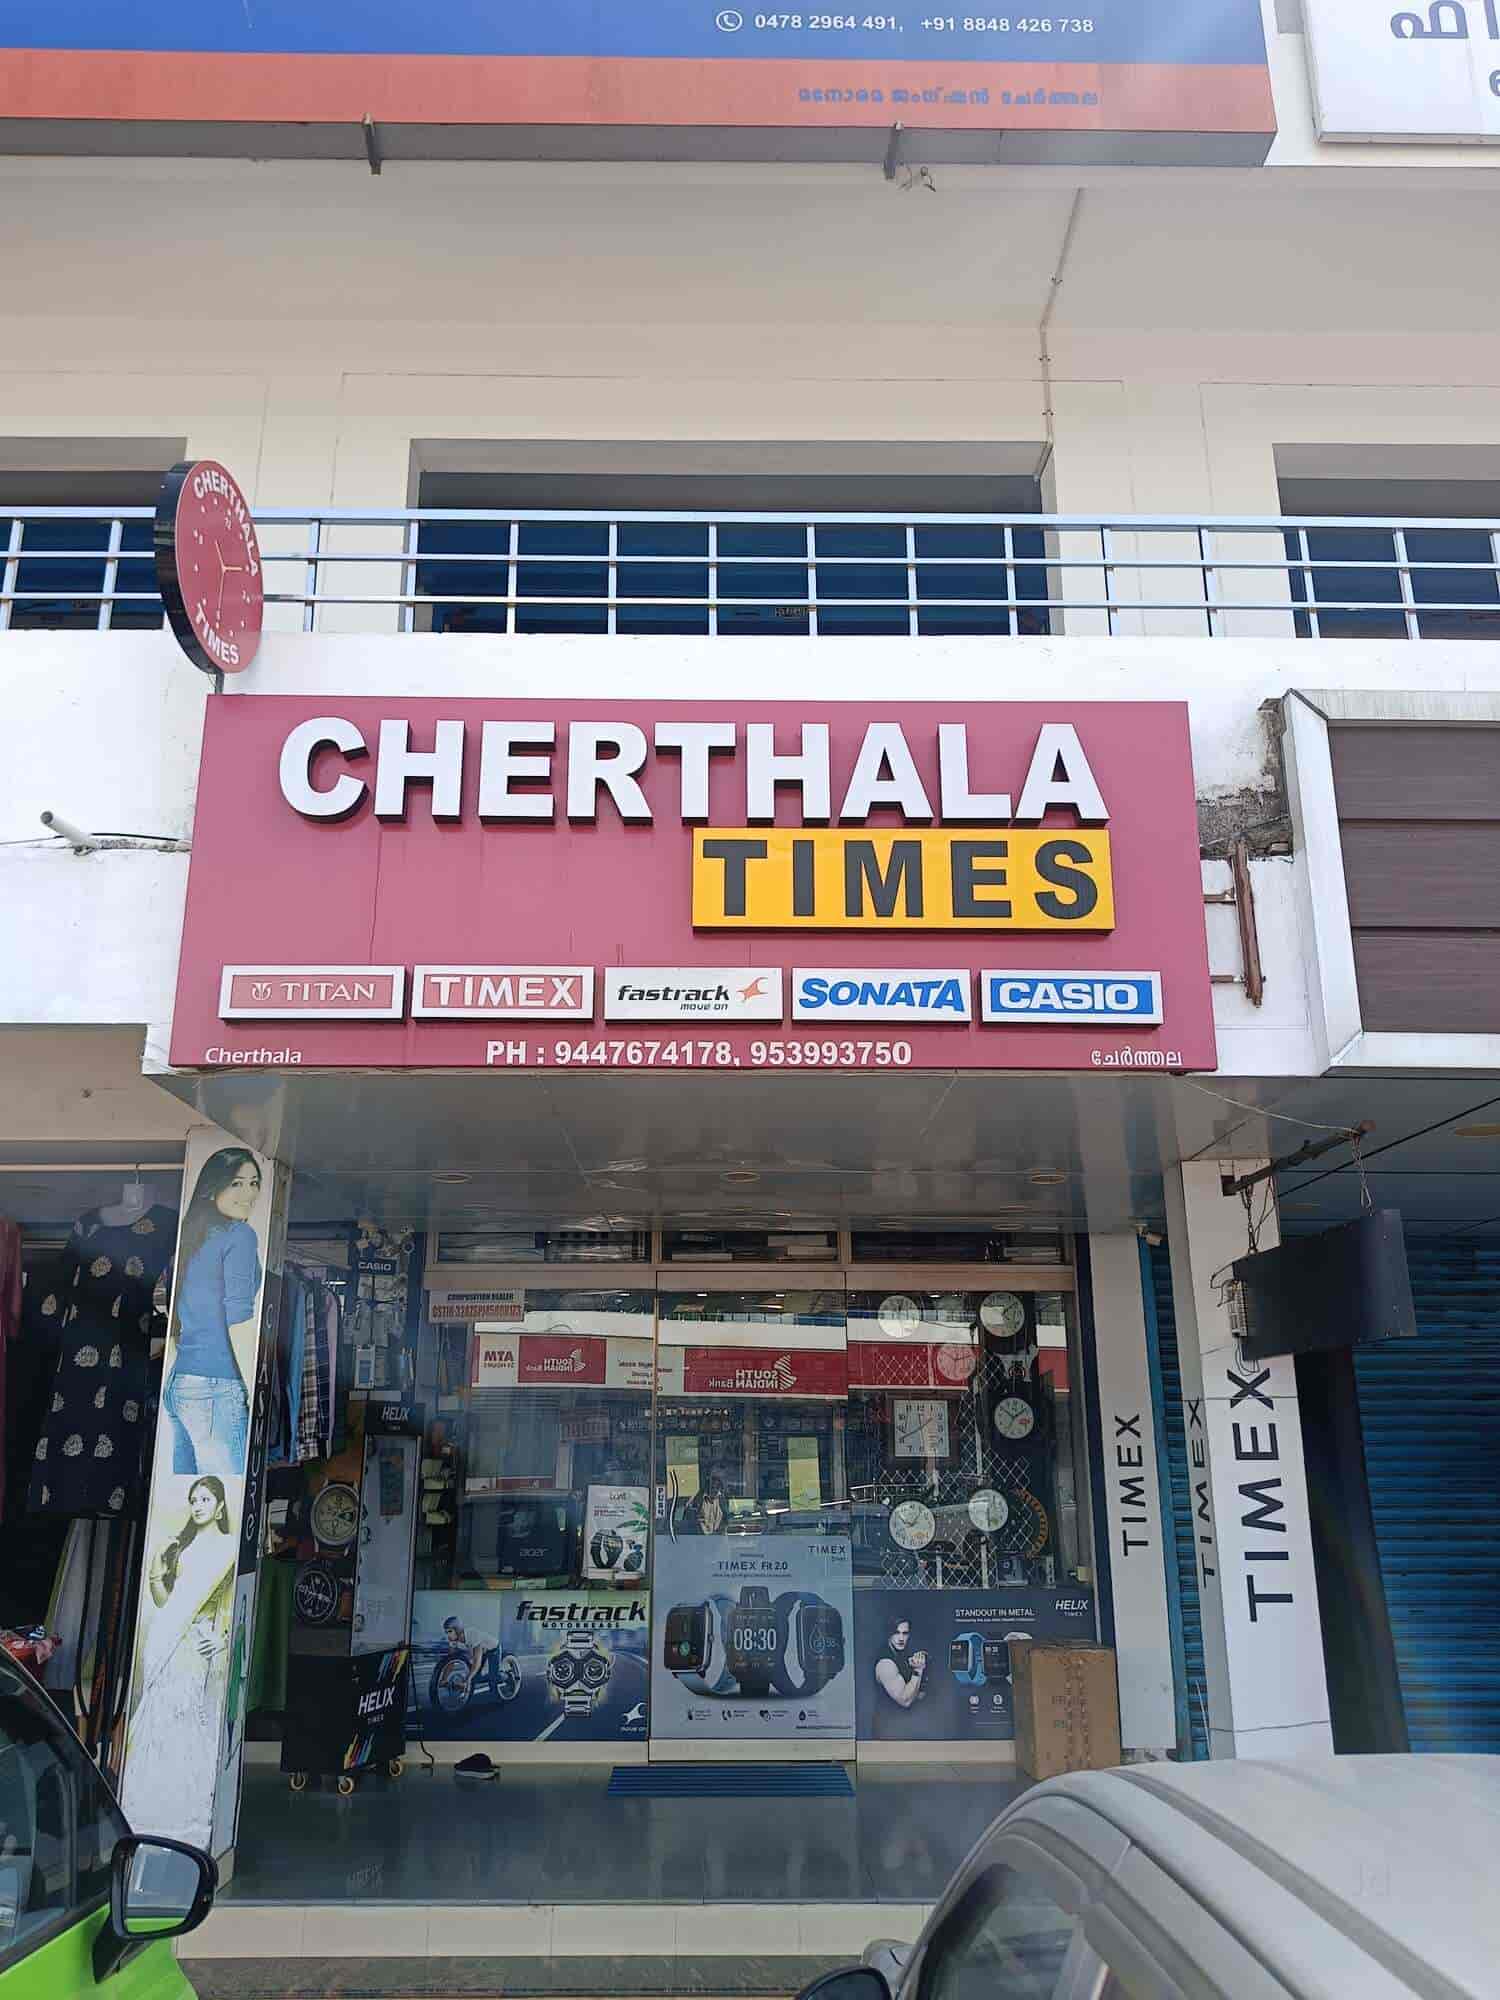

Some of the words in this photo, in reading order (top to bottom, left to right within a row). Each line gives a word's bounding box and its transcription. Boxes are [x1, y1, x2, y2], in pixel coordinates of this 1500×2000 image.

[755, 15, 801, 29] 0478
[809, 15, 856, 30] 2964
[862, 16, 903, 32] 491,
[921, 19, 955, 32] +91
[963, 18, 1010, 33] 8848
[1016, 18, 1051, 33] 426
[1060, 19, 1094, 33] 738
[193, 468, 259, 577] CHERTHALA
[195, 602, 240, 665] TIMES
[279, 716, 1110, 827] CHERTHALA
[702, 839, 1099, 920] TIMES
[280, 983, 376, 1001] TITAN
[430, 976, 577, 1007] TIMEX
[617, 985, 730, 1001] fastrack
[798, 977, 965, 1012] SONATA
[999, 981, 1140, 1012] CASIO
[680, 1003, 709, 1011] move
[714, 1003, 728, 1011] on
[205, 1047, 303, 1066] Cherthala
[486, 1041, 527, 1064] PH
[554, 1041, 741, 1067] 9447674178,
[750, 1042, 912, 1064] 953993750
[1091, 1045, 1182, 1066] ചേർത്തല
[382, 1407, 410, 1420] HELIX
[1114, 1413, 1149, 1557] TIMEX
[1188, 1397, 1215, 1588] TIMEX
[1227, 1367, 1294, 1622] TIMEX
[808, 1545, 846, 1554] TIMEX
[718, 1561, 756, 1571] TIMEX
[516, 1601, 646, 1621] fastrack
[955, 1608, 996, 1617] STANDOUT
[1009, 1607, 1035, 1617] METAL
[1055, 1600, 1088, 1610] HELIX
[734, 1628, 777, 1651] 08:30
[358, 1687, 395, 1715] HELIX
